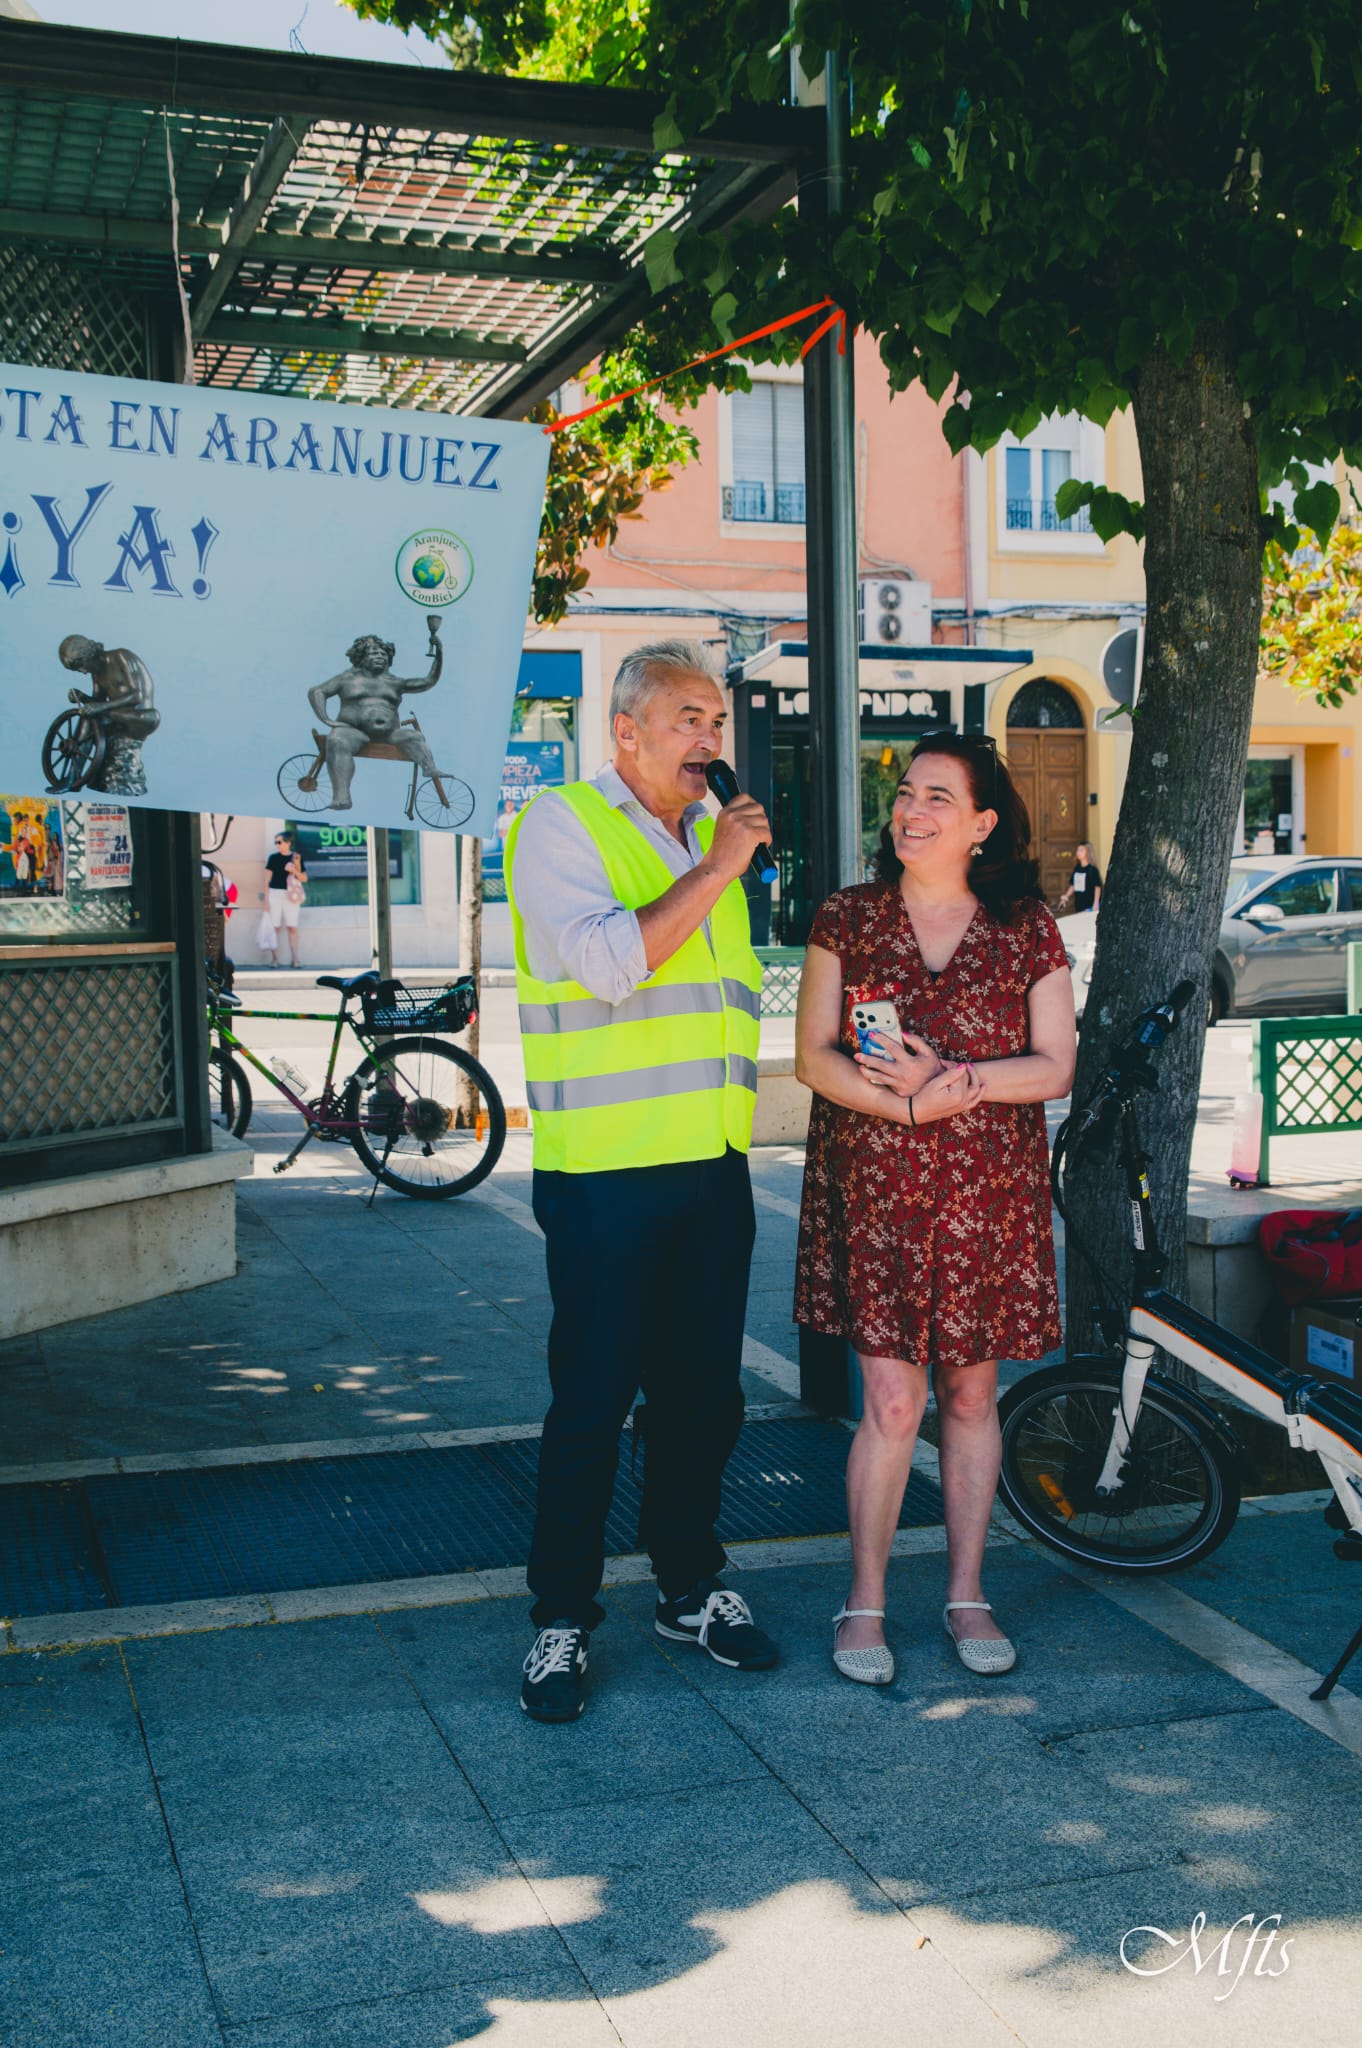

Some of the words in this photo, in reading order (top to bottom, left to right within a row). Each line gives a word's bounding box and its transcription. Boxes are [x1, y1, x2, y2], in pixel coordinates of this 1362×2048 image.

[0, 388, 88, 448] TA
[108, 400, 180, 456] EN
[199, 412, 502, 492] ARANJUEZ
[0, 481, 219, 600] ¡YA!
[414, 534, 460, 551] Aranjuez
[412, 589, 453, 603] ConBici
[114, 835, 128, 851] 24
[110, 852, 131, 865] MAYO
